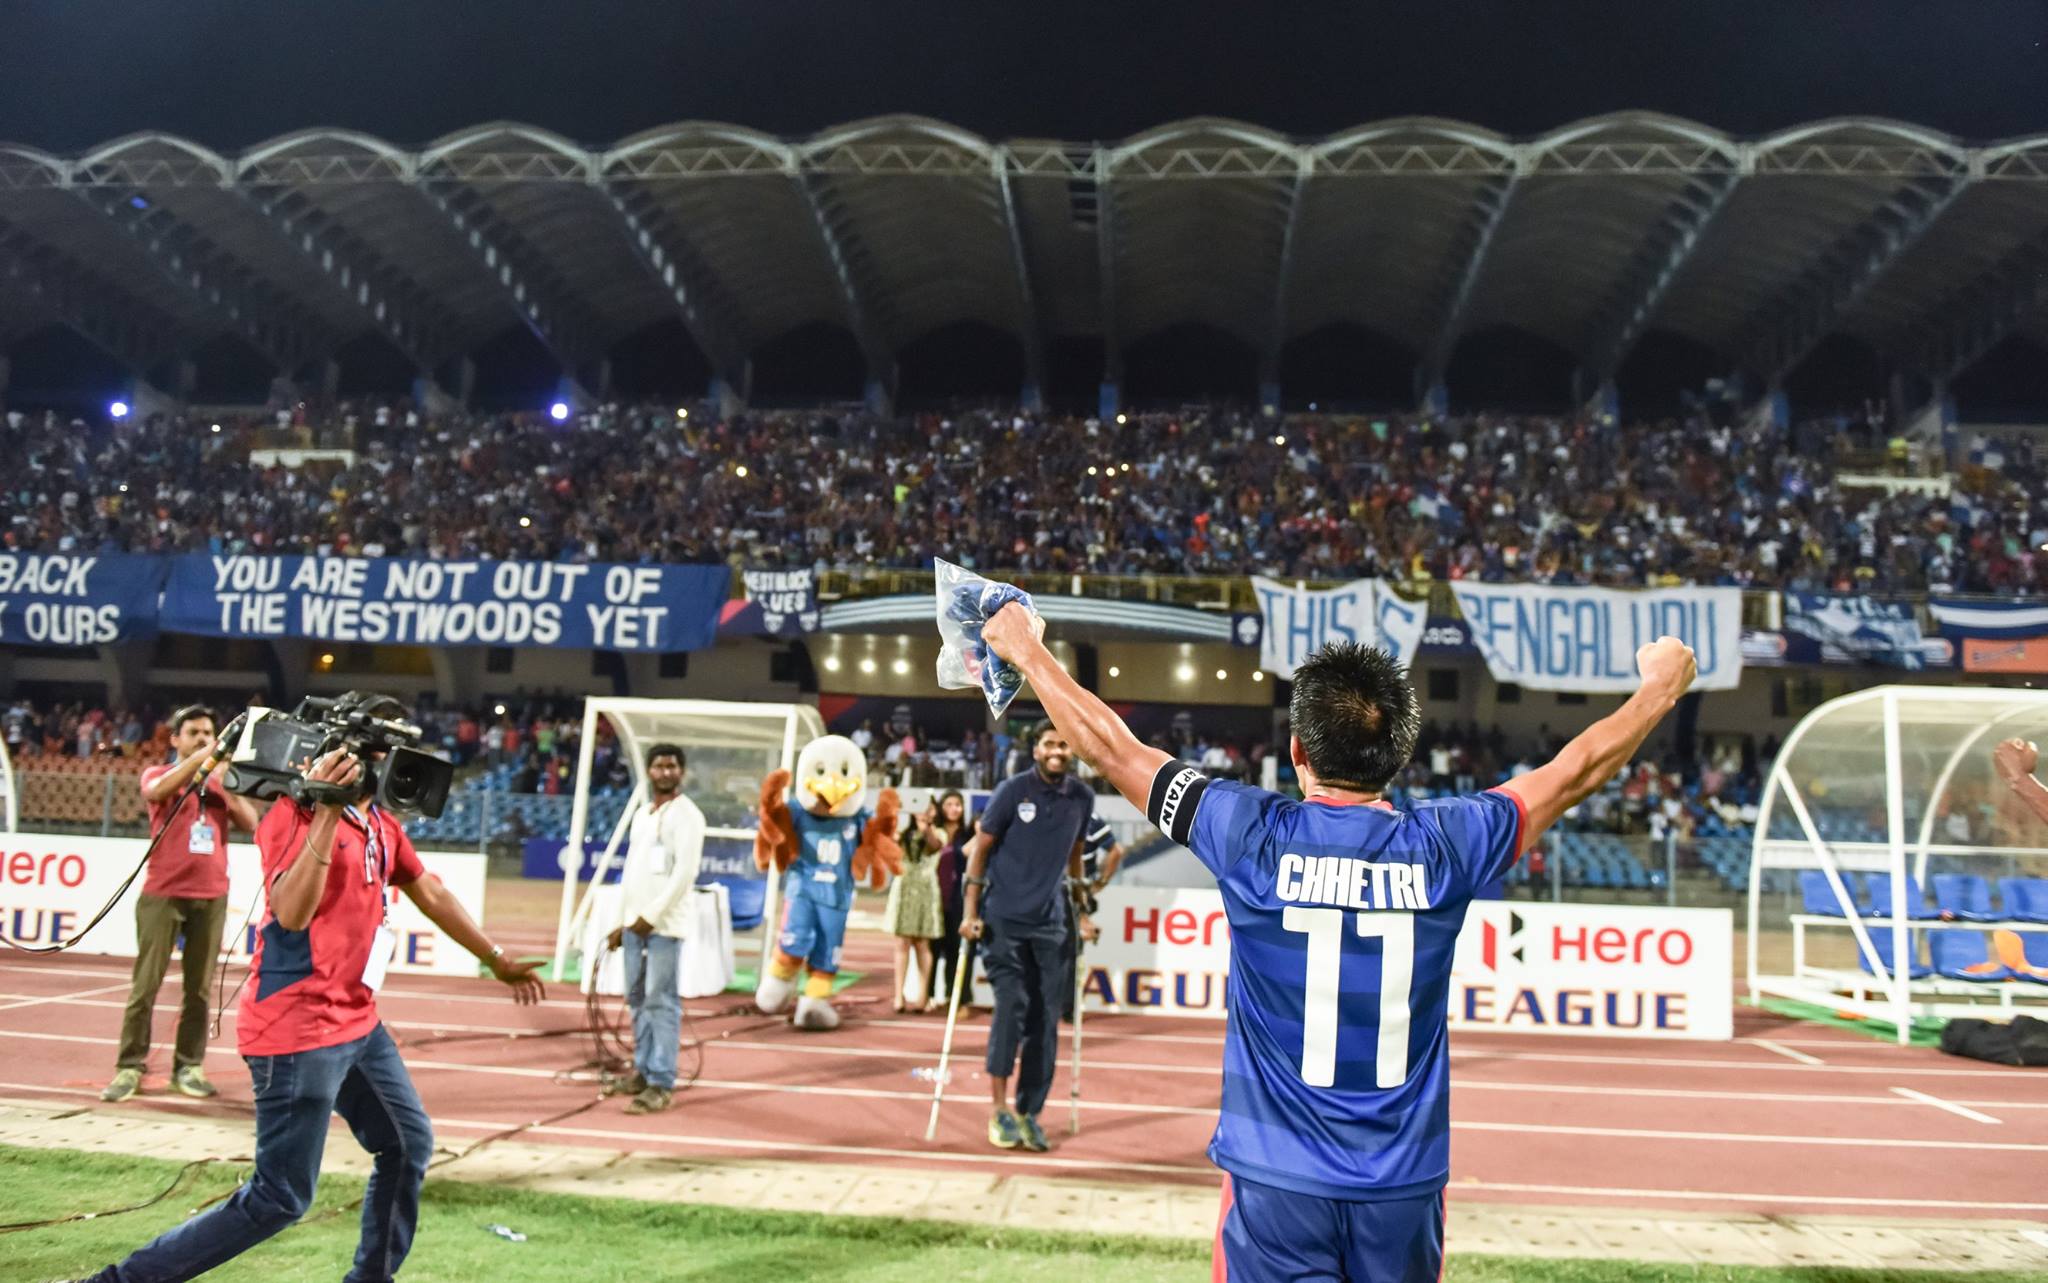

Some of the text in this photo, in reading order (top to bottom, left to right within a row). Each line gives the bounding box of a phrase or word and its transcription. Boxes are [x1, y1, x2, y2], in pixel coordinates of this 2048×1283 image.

[0, 555, 97, 596] BACK
[212, 556, 662, 604] YOU ARE NOT OUT OF
[25, 602, 120, 645] OURS
[216, 593, 668, 648] THE WESTWOODS YET
[1162, 770, 1197, 827] APTAIN
[1276, 853, 1430, 910] CHHETRI
[0, 906, 77, 944] UE
[1123, 906, 1230, 946] Her
[1552, 926, 1694, 966] Hero
[1283, 906, 1414, 1089] 11
[1449, 985, 1688, 1032] EAGUE
